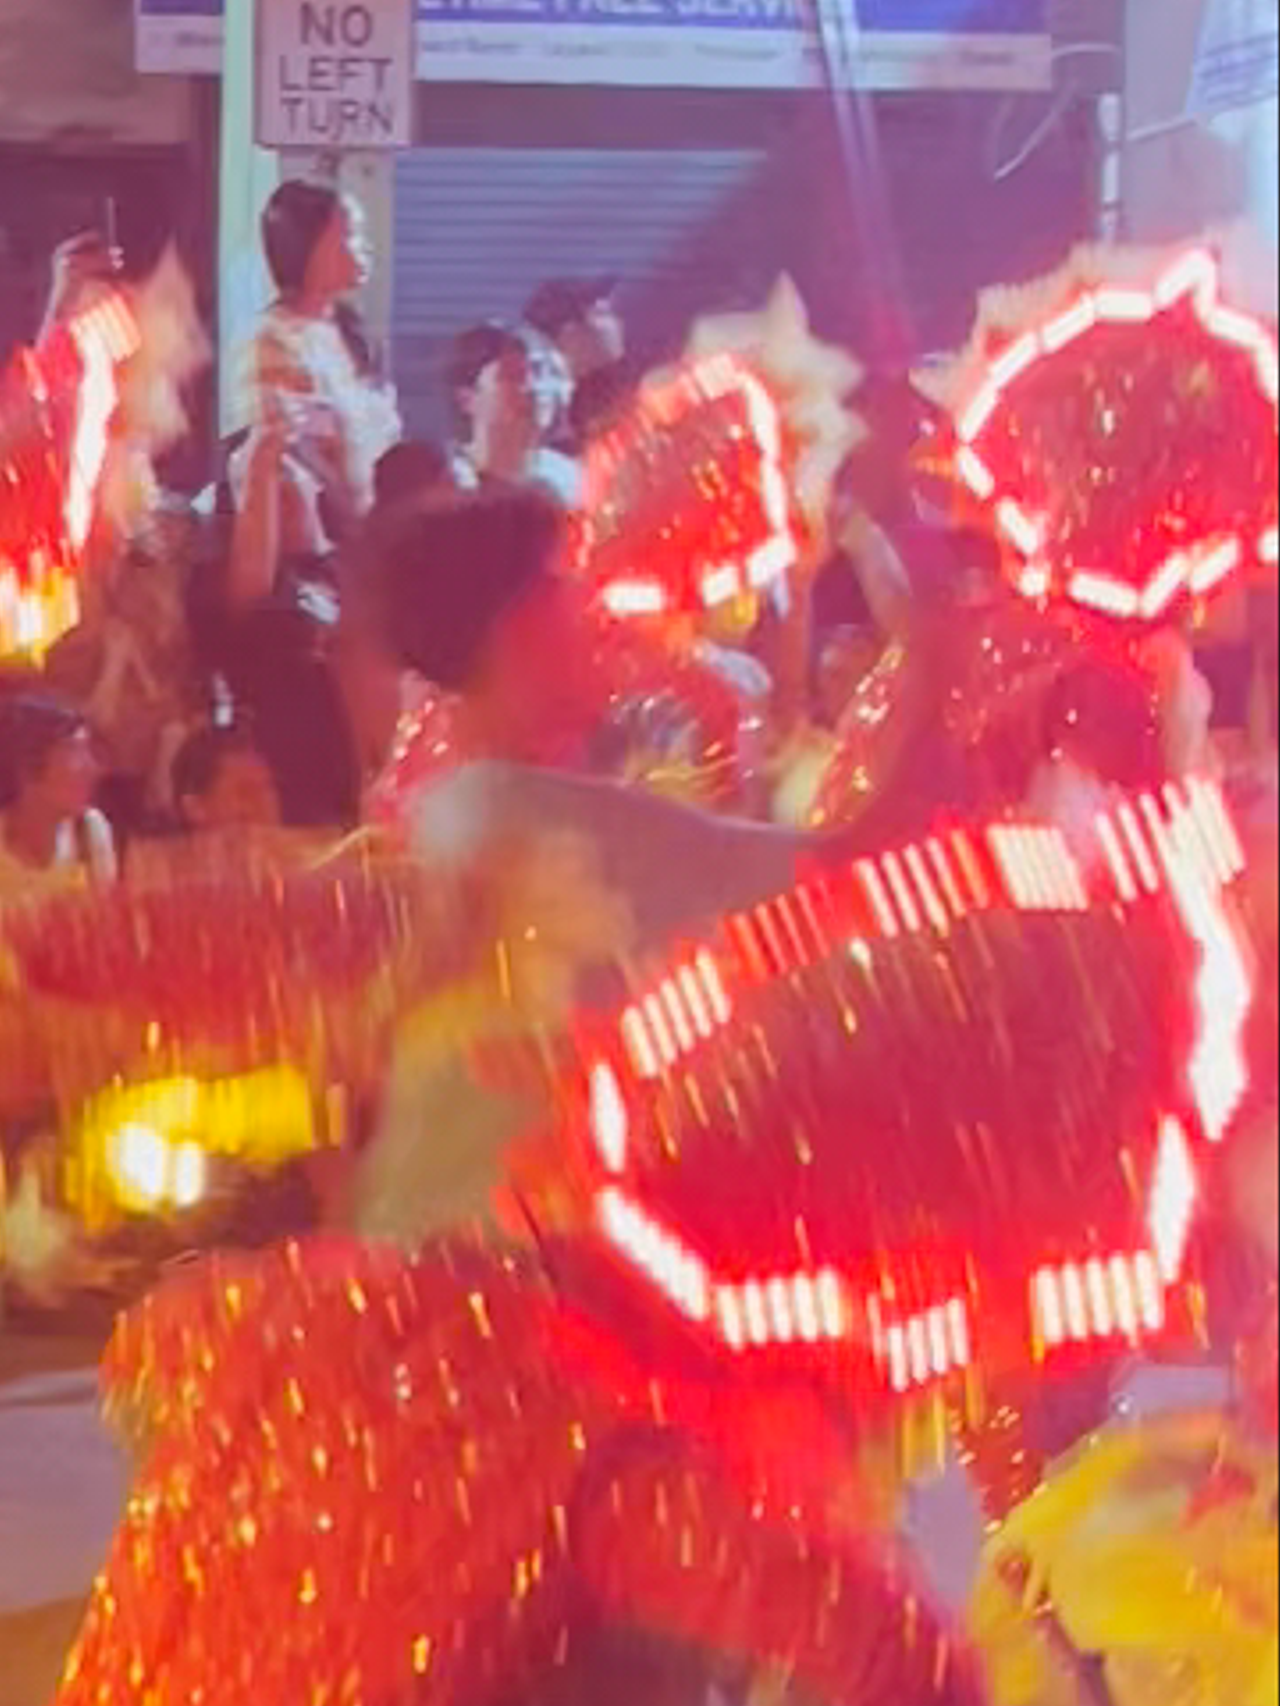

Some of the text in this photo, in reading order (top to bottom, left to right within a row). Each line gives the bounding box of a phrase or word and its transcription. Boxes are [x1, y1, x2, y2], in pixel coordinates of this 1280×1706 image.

[299, 2, 374, 47] NO
[279, 54, 393, 93] LEFT
[280, 96, 394, 136] TURN
